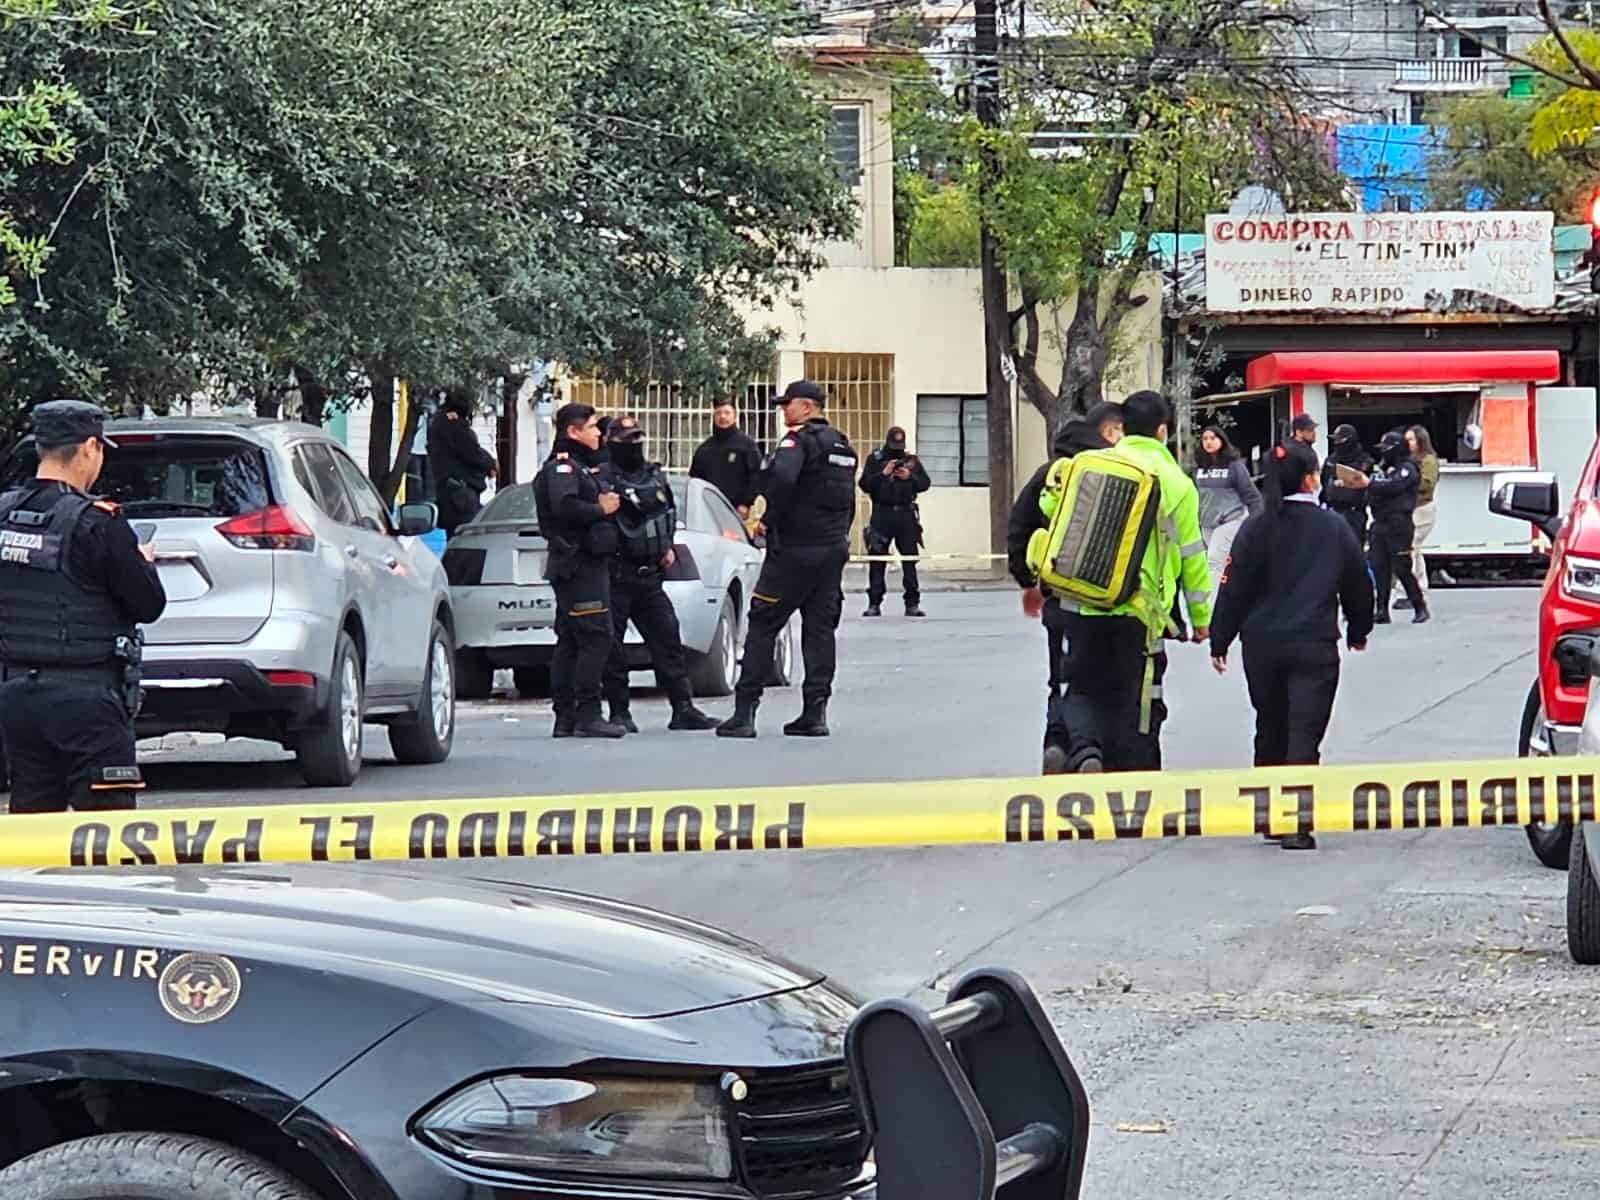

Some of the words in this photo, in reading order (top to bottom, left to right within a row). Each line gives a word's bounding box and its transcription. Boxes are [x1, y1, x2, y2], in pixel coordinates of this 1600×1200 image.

[1213, 218, 1353, 242] COMPRA
[1240, 287, 1313, 302] DINERO
[1332, 287, 1404, 301] RAPIDO
[1, 546, 30, 564] CIVIL
[408, 801, 807, 860] PROHIBIDO
[1005, 787, 1203, 842] PASO
[1238, 784, 1315, 835] EL
[70, 818, 265, 867] PASO
[299, 814, 375, 861] EL
[0, 944, 159, 978] ERvIR
